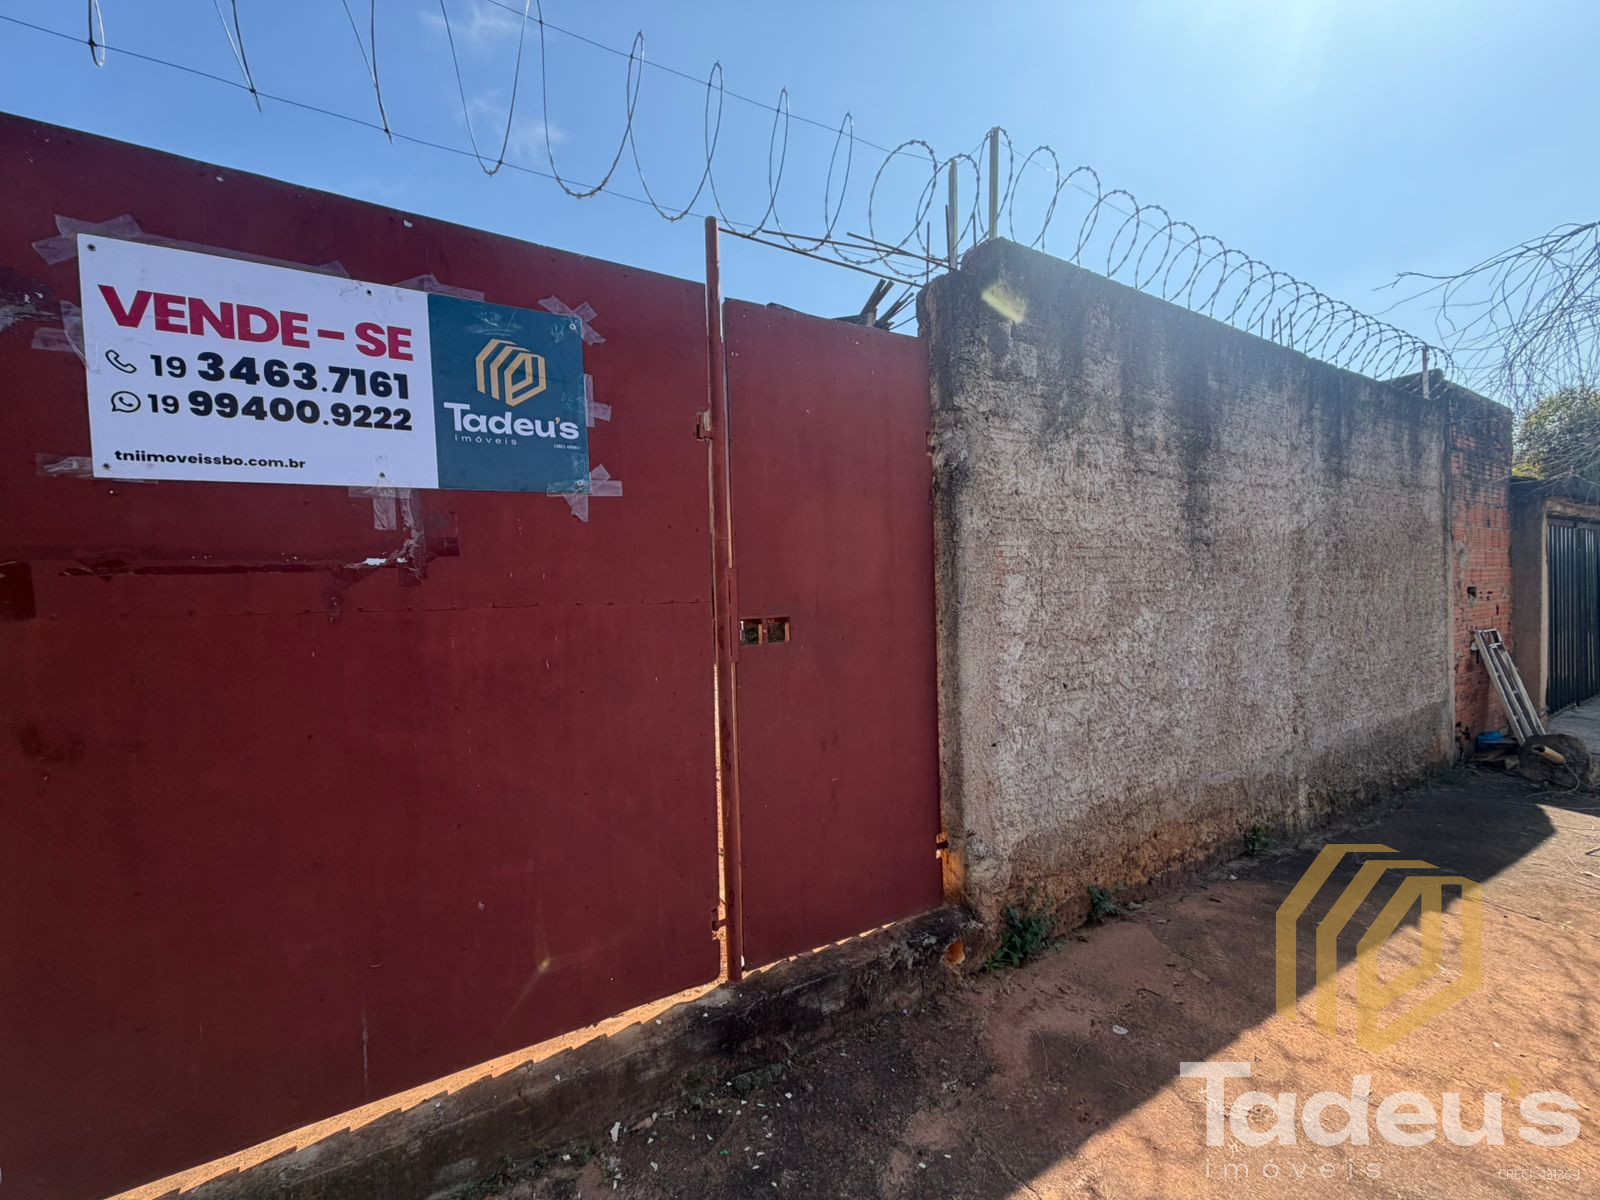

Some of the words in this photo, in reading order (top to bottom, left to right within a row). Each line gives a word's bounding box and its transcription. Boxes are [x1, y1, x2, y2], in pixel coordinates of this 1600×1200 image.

[150, 354, 187, 378] 19
[197, 351, 409, 400] 3463.7161
[147, 393, 180, 414] 19
[188, 390, 413, 431] 99400.9222
[443, 402, 580, 440] Tadeu's
[115, 450, 306, 469] tniimoveissbo.com.br
